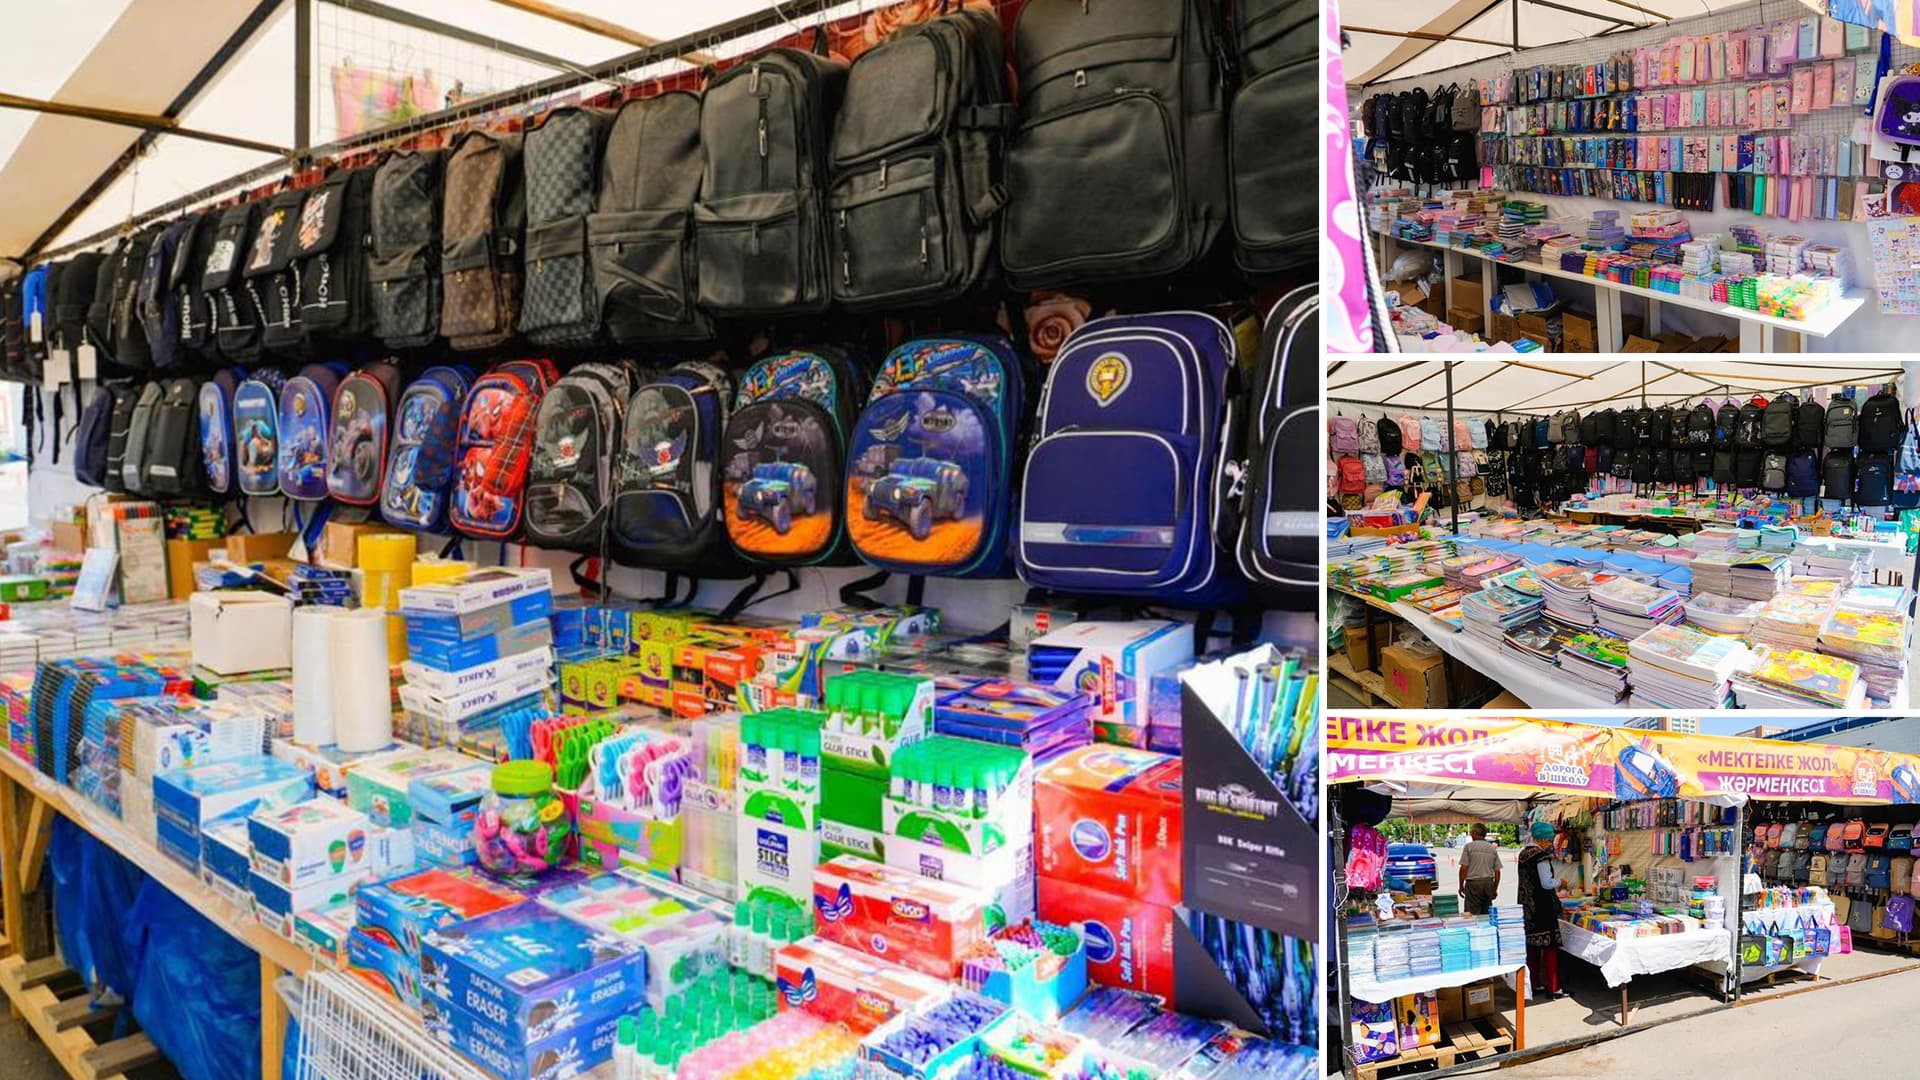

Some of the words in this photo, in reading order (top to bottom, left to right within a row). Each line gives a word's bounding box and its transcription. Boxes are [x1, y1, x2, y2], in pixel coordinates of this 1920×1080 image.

[823, 742, 843, 754] GLUE
[845, 746, 868, 759] STICK
[1544, 764, 1584, 775] ДОРОГА
[1697, 750, 1794, 770] «МЕКТЕПКЕ
[1799, 756, 1838, 772] ЖОЛ»
[1539, 773, 1546, 781] В
[1550, 774, 1588, 785] ШКОЛУ
[1718, 776, 1826, 796] ЖӘРМЕҢКЕСІ
[824, 832, 844, 844] GLUE
[846, 837, 869, 849] STICK
[758, 848, 788, 866] STICK
[1120, 918, 1132, 938] Pen
[1120, 940, 1132, 959] Ink
[1120, 960, 1133, 983] Soft
[591, 981, 626, 1004] ERASER
[466, 989, 509, 1026] ERASER
[592, 1032, 617, 1051] ERAS
[469, 1037, 511, 1074] ERASER
